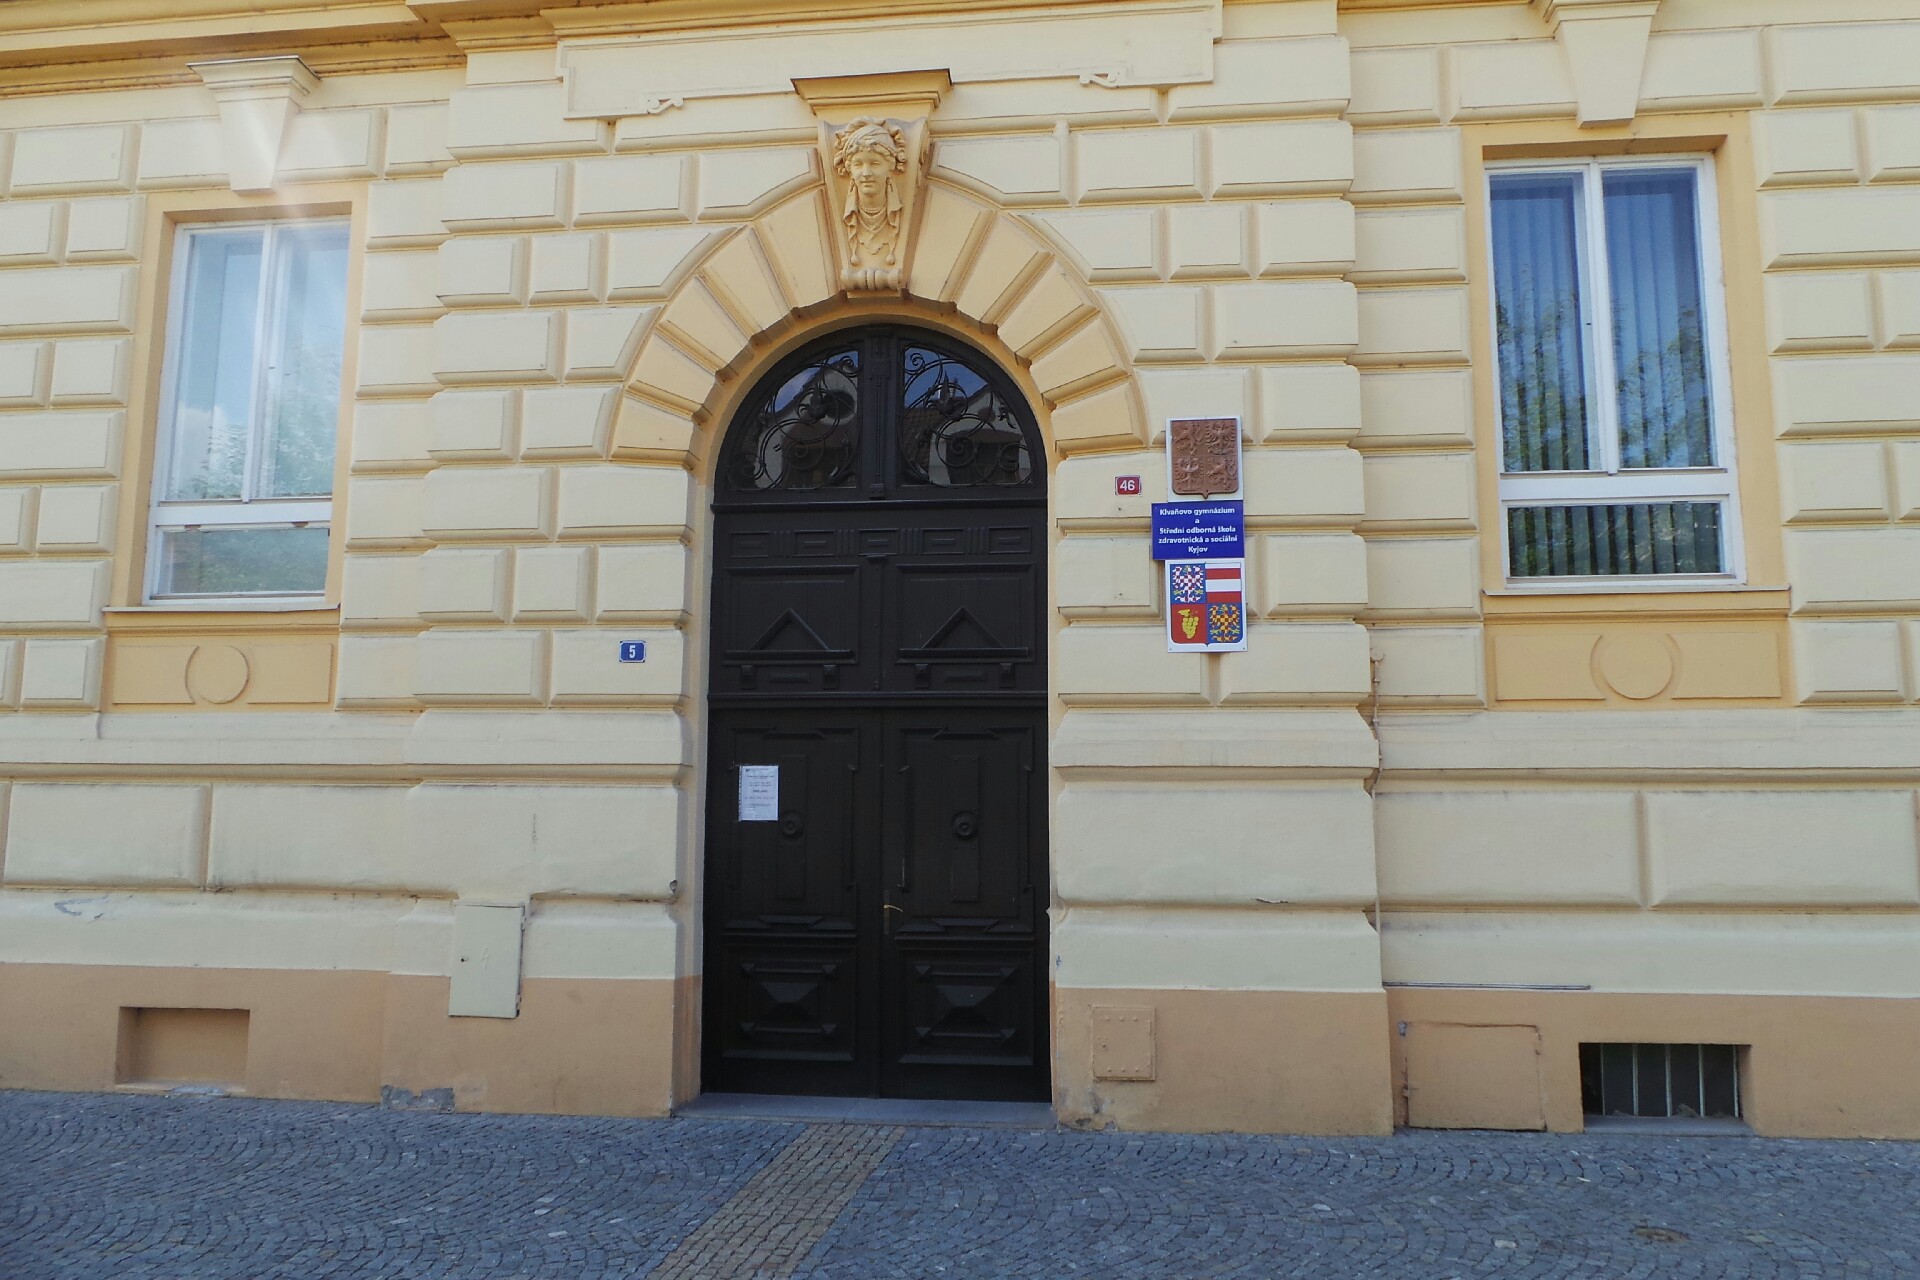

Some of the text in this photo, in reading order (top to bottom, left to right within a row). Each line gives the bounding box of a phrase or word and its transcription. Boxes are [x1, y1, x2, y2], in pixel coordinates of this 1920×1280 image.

[1120, 480, 1135, 491] 46
[1159, 507, 1235, 516] Klvaňovo gymnázium
[1159, 525, 1236, 535] Střední odborná škola
[1158, 536, 1204, 544] zdravotnická
[1211, 535, 1238, 543] sociální
[1188, 546, 1208, 554] Kyjov
[629, 645, 636, 659] 5
